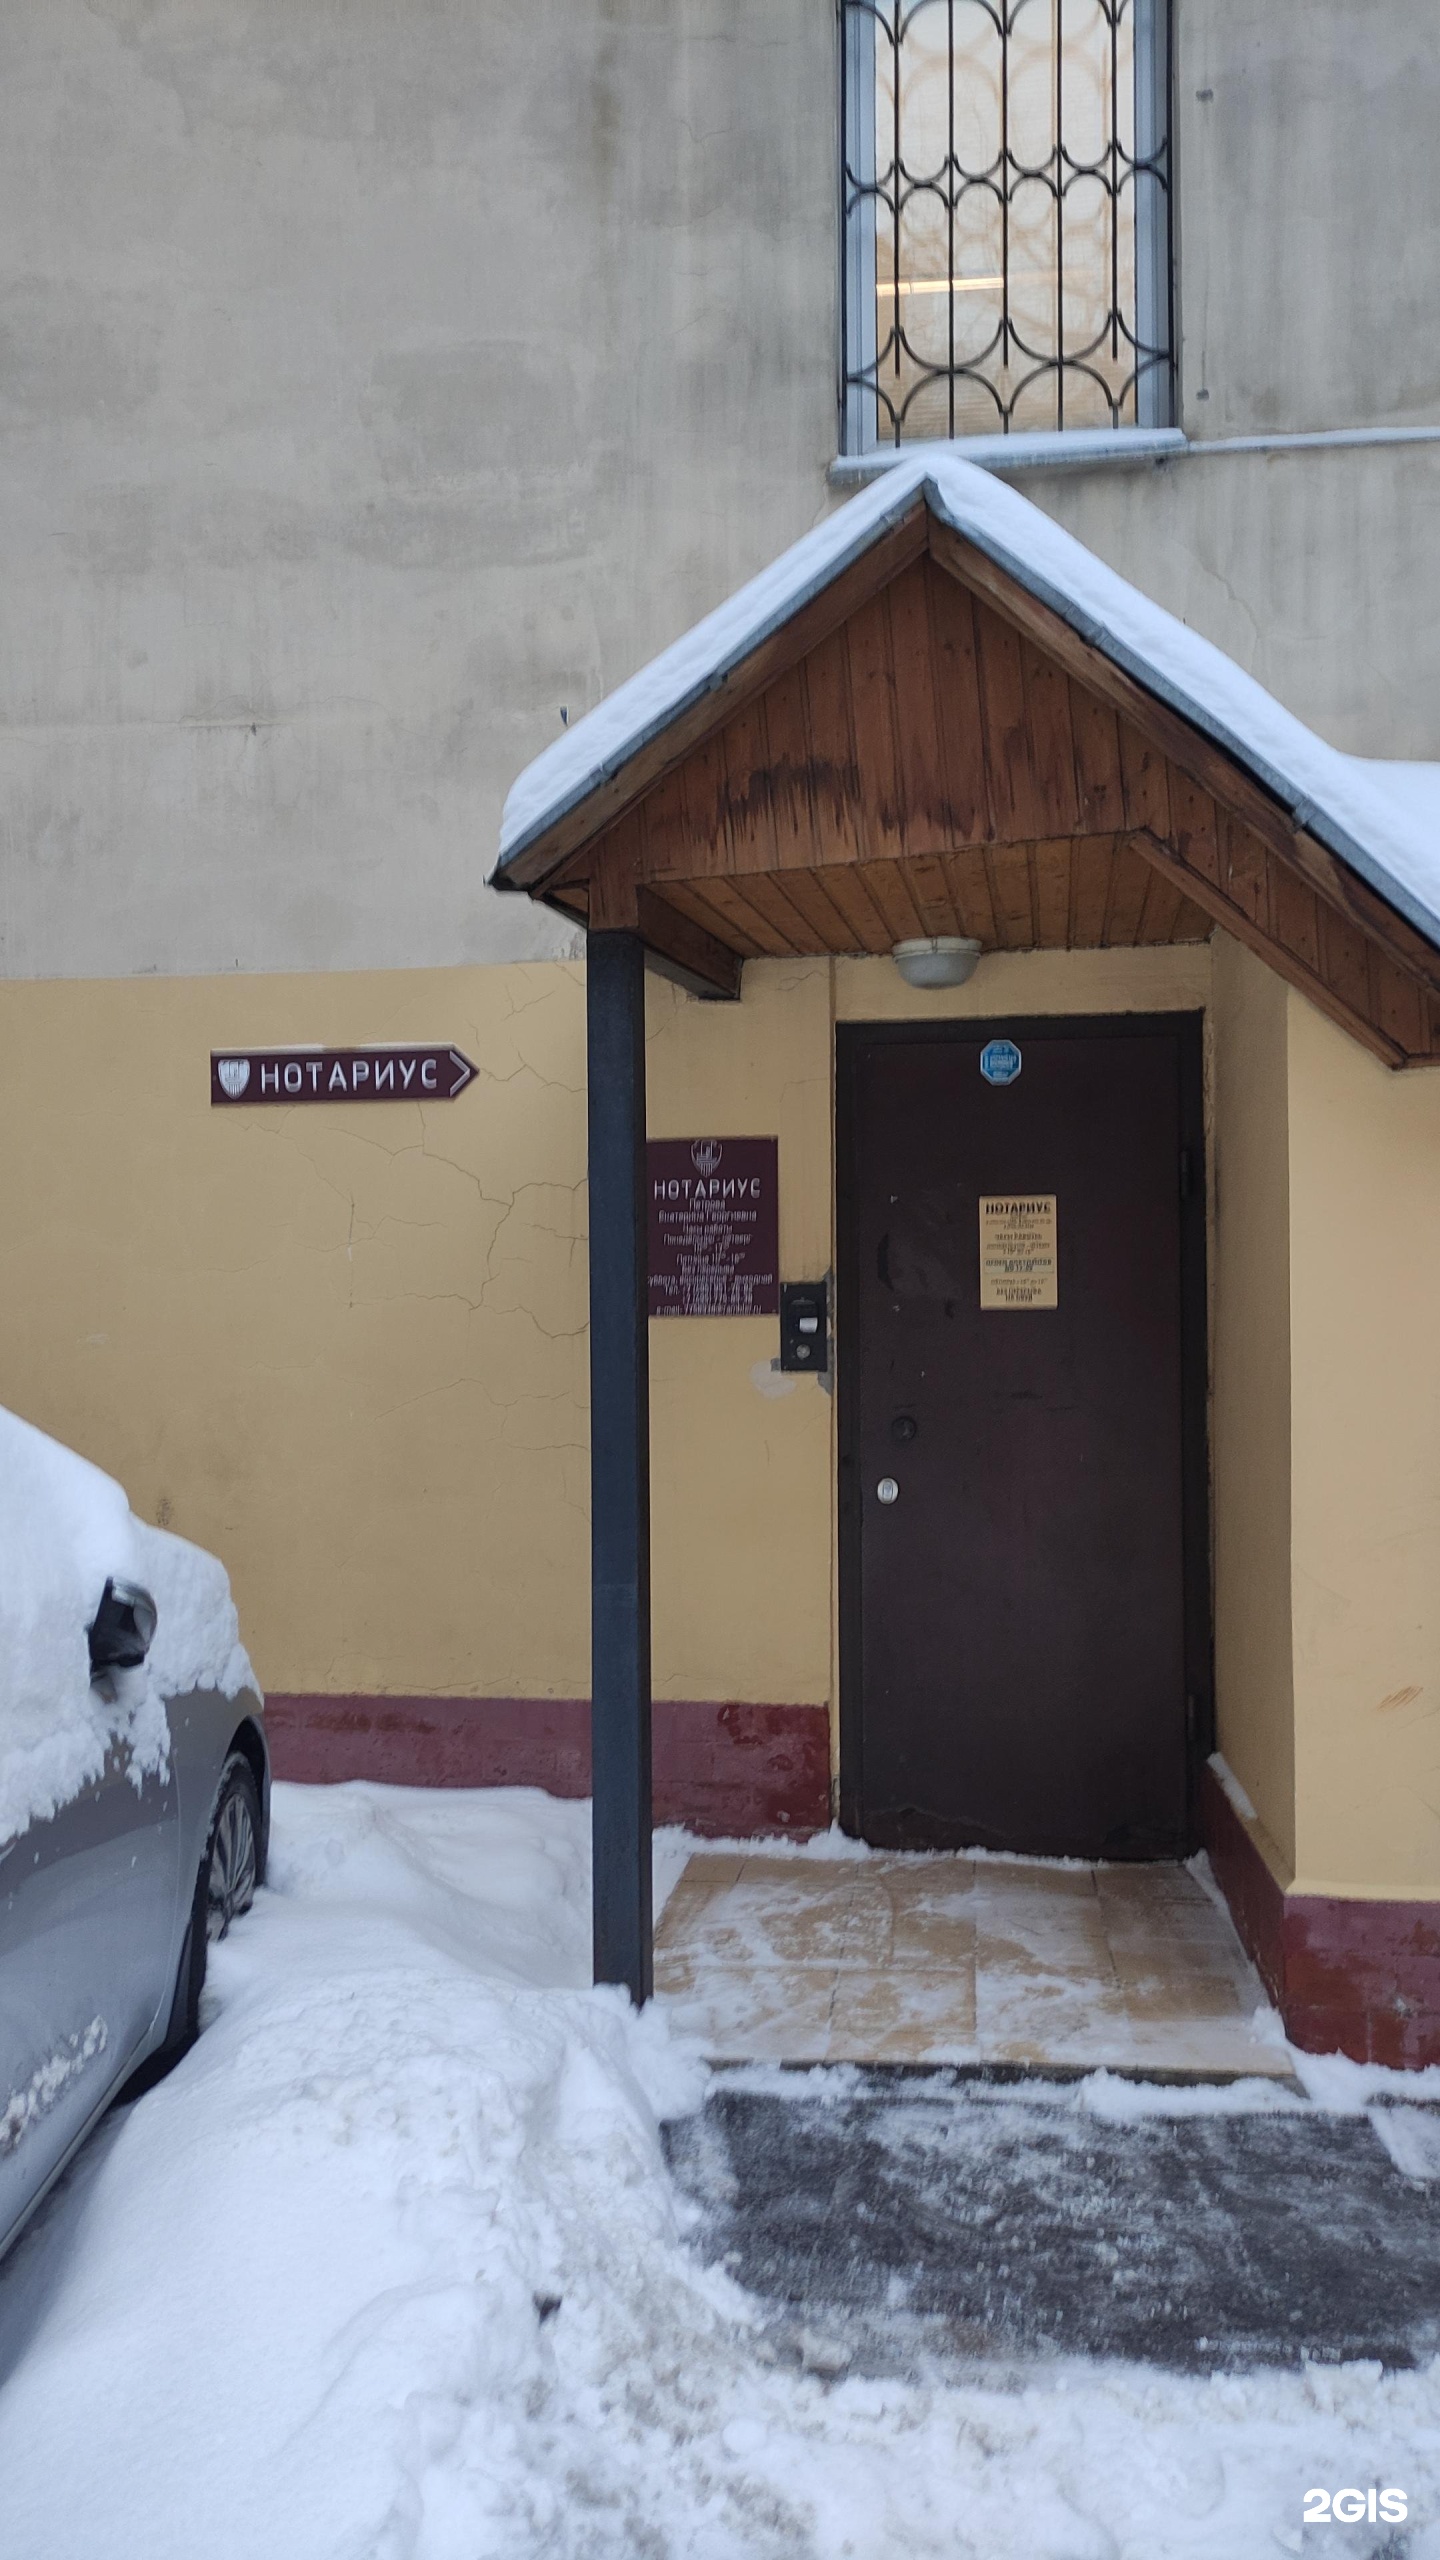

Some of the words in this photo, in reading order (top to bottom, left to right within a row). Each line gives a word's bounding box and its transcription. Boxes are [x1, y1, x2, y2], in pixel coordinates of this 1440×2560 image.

[260, 1058, 438, 1094] НОТАРИУС
[654, 1178, 761, 1200] НОТАРИУС
[985, 1202, 1052, 1214] НОТАРИУС
